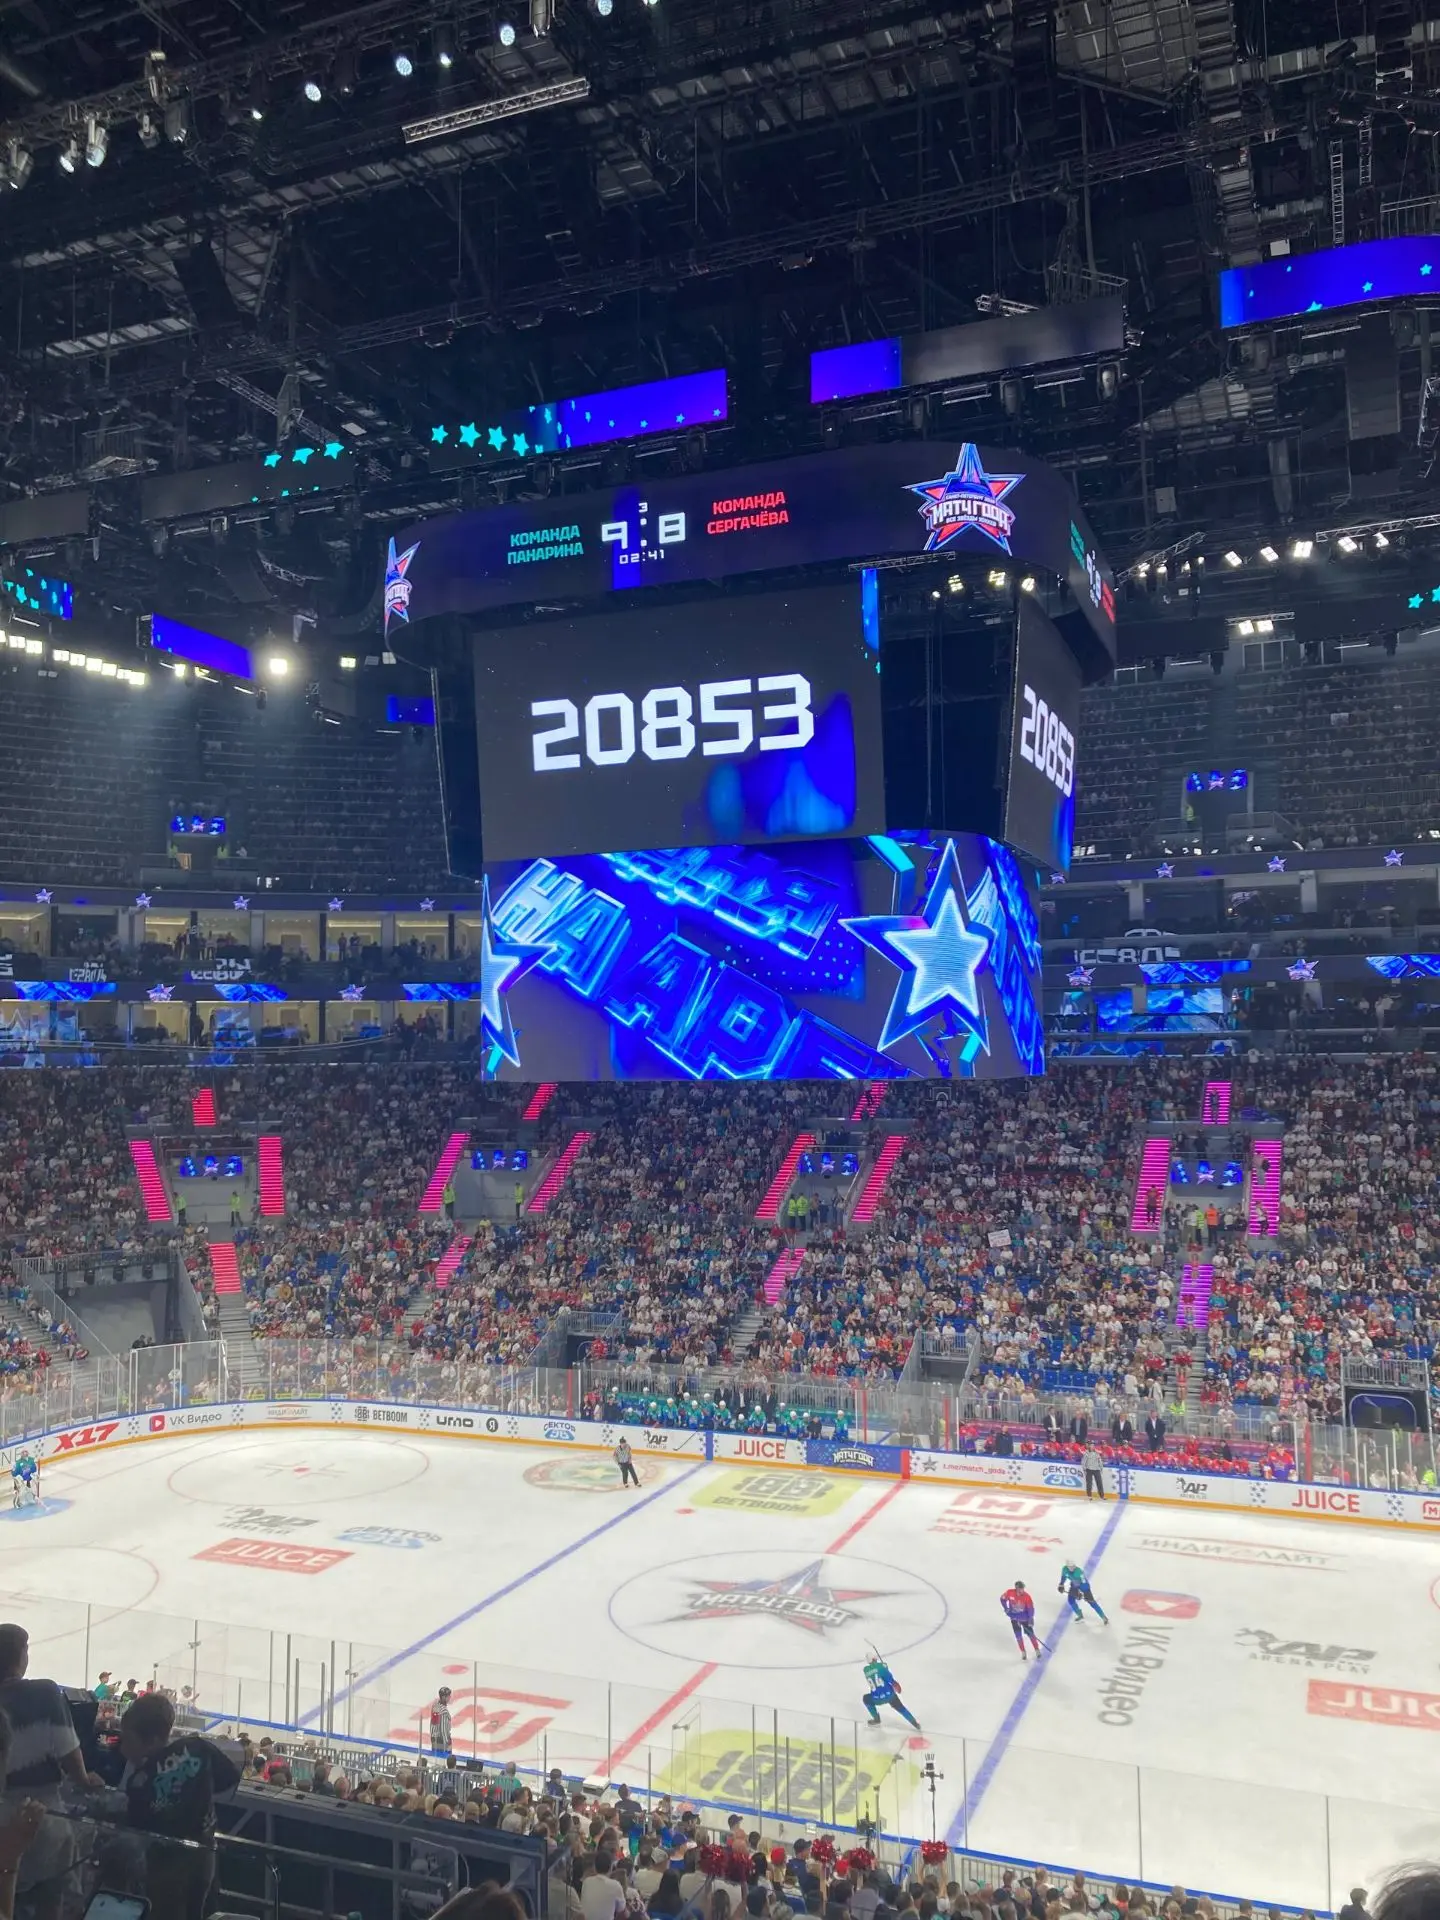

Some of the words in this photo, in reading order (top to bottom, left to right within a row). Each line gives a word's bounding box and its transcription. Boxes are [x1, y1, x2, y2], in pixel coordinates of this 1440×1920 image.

[638, 502, 648, 513] 3
[710, 491, 786, 515] КОМАНДА
[707, 510, 789, 534] СЕРГАЧЁВА
[510, 524, 580, 547] КОМАНДА
[507, 542, 584, 564] ПАНАРИНА
[619, 549, 665, 565] 02:41
[531, 673, 815, 771] 20853
[1020, 684, 1075, 798] 20853
[169, 1416, 185, 1426] VK
[187, 1412, 222, 1424] Видео
[373, 1410, 408, 1422] BETBOOM
[53, 1422, 120, 1453] X17
[734, 1440, 785, 1459] JUICE
[1043, 1465, 1084, 1478] СЕКТОР
[711, 1496, 810, 1513] BETBOOM
[1291, 1489, 1361, 1513] JUICE
[212, 1543, 339, 1567] JUICE
[1124, 1625, 1175, 1653] VK
[1249, 1652, 1315, 1668] ARENA
[1323, 1662, 1371, 1675] PLAY
[1096, 1652, 1165, 1727] Видео
